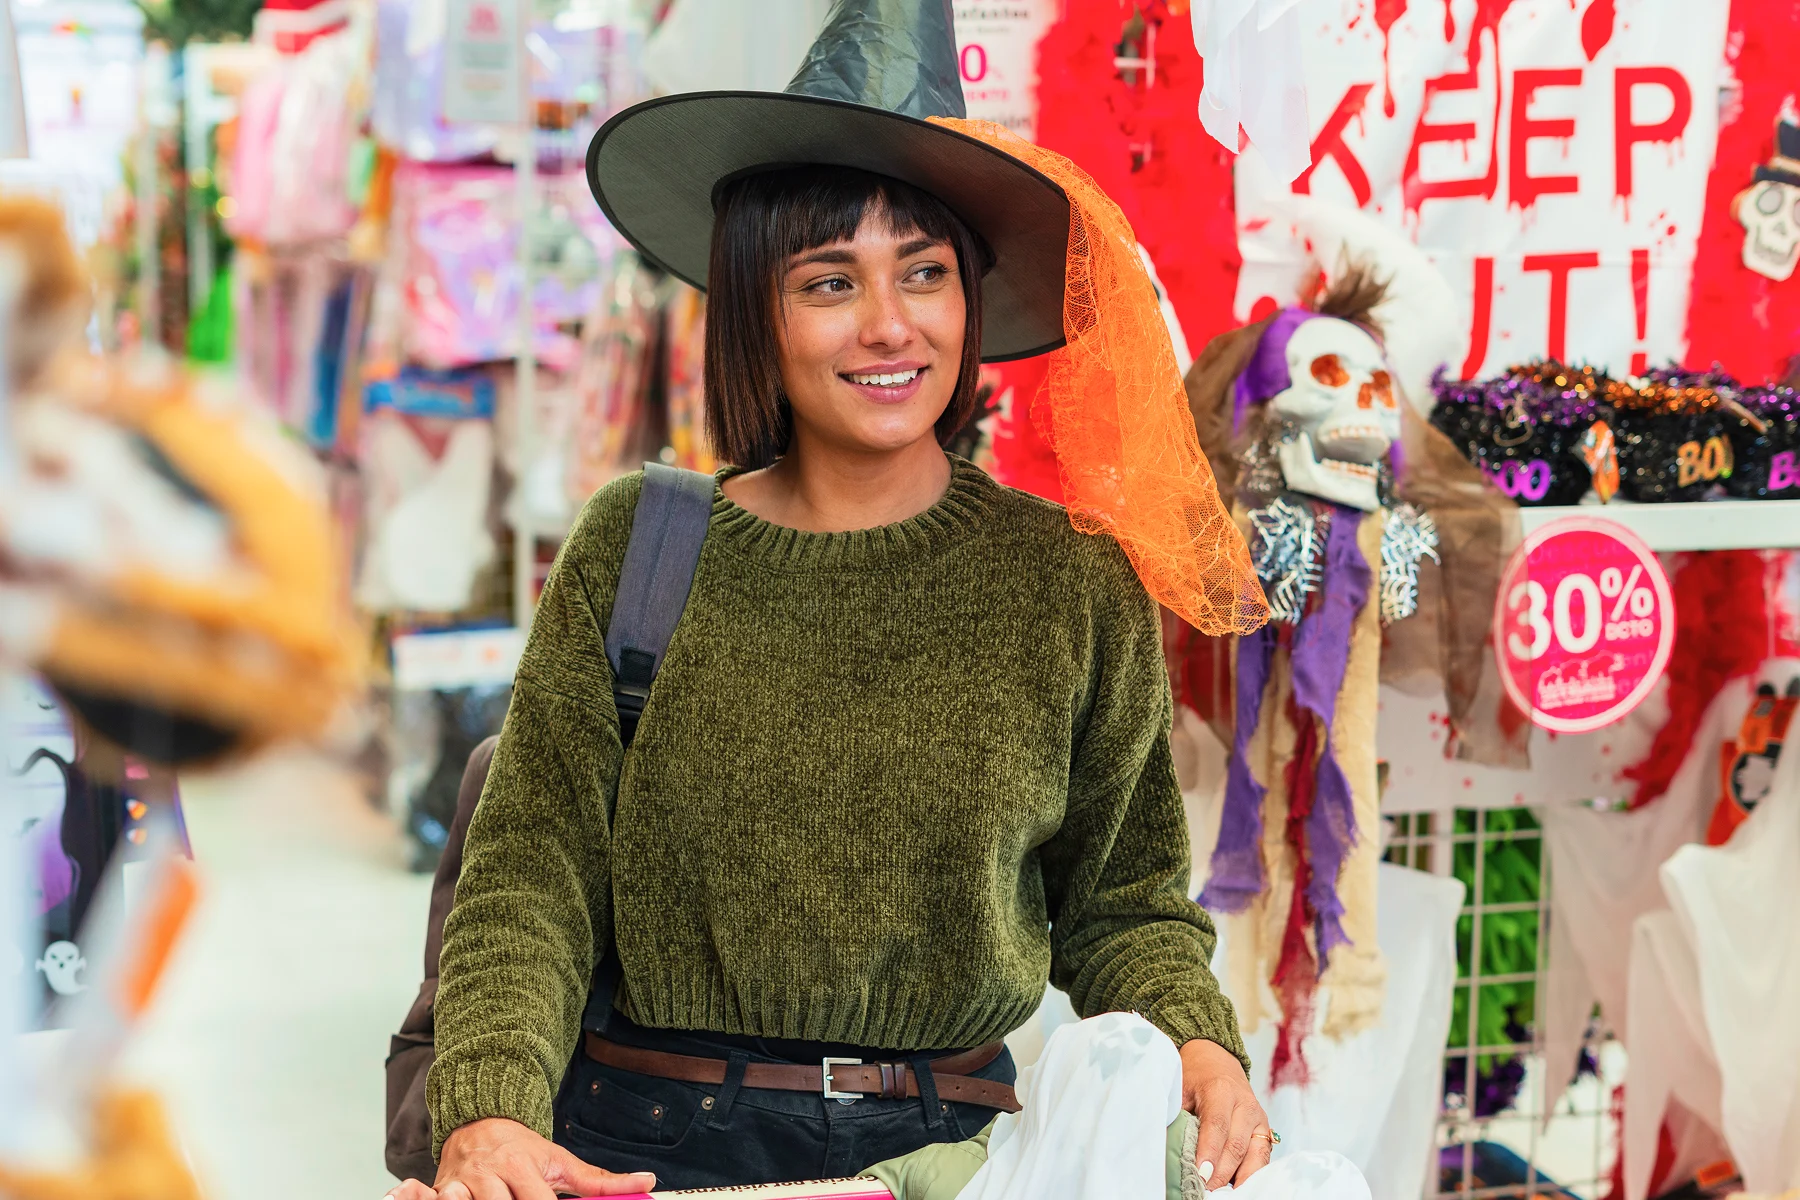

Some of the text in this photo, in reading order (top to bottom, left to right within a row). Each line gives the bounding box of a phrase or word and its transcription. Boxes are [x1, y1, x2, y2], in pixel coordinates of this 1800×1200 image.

[1292, 66, 1694, 210] KEEP
[1508, 564, 1654, 661] 30%
[1605, 618, 1654, 641] DCTO
